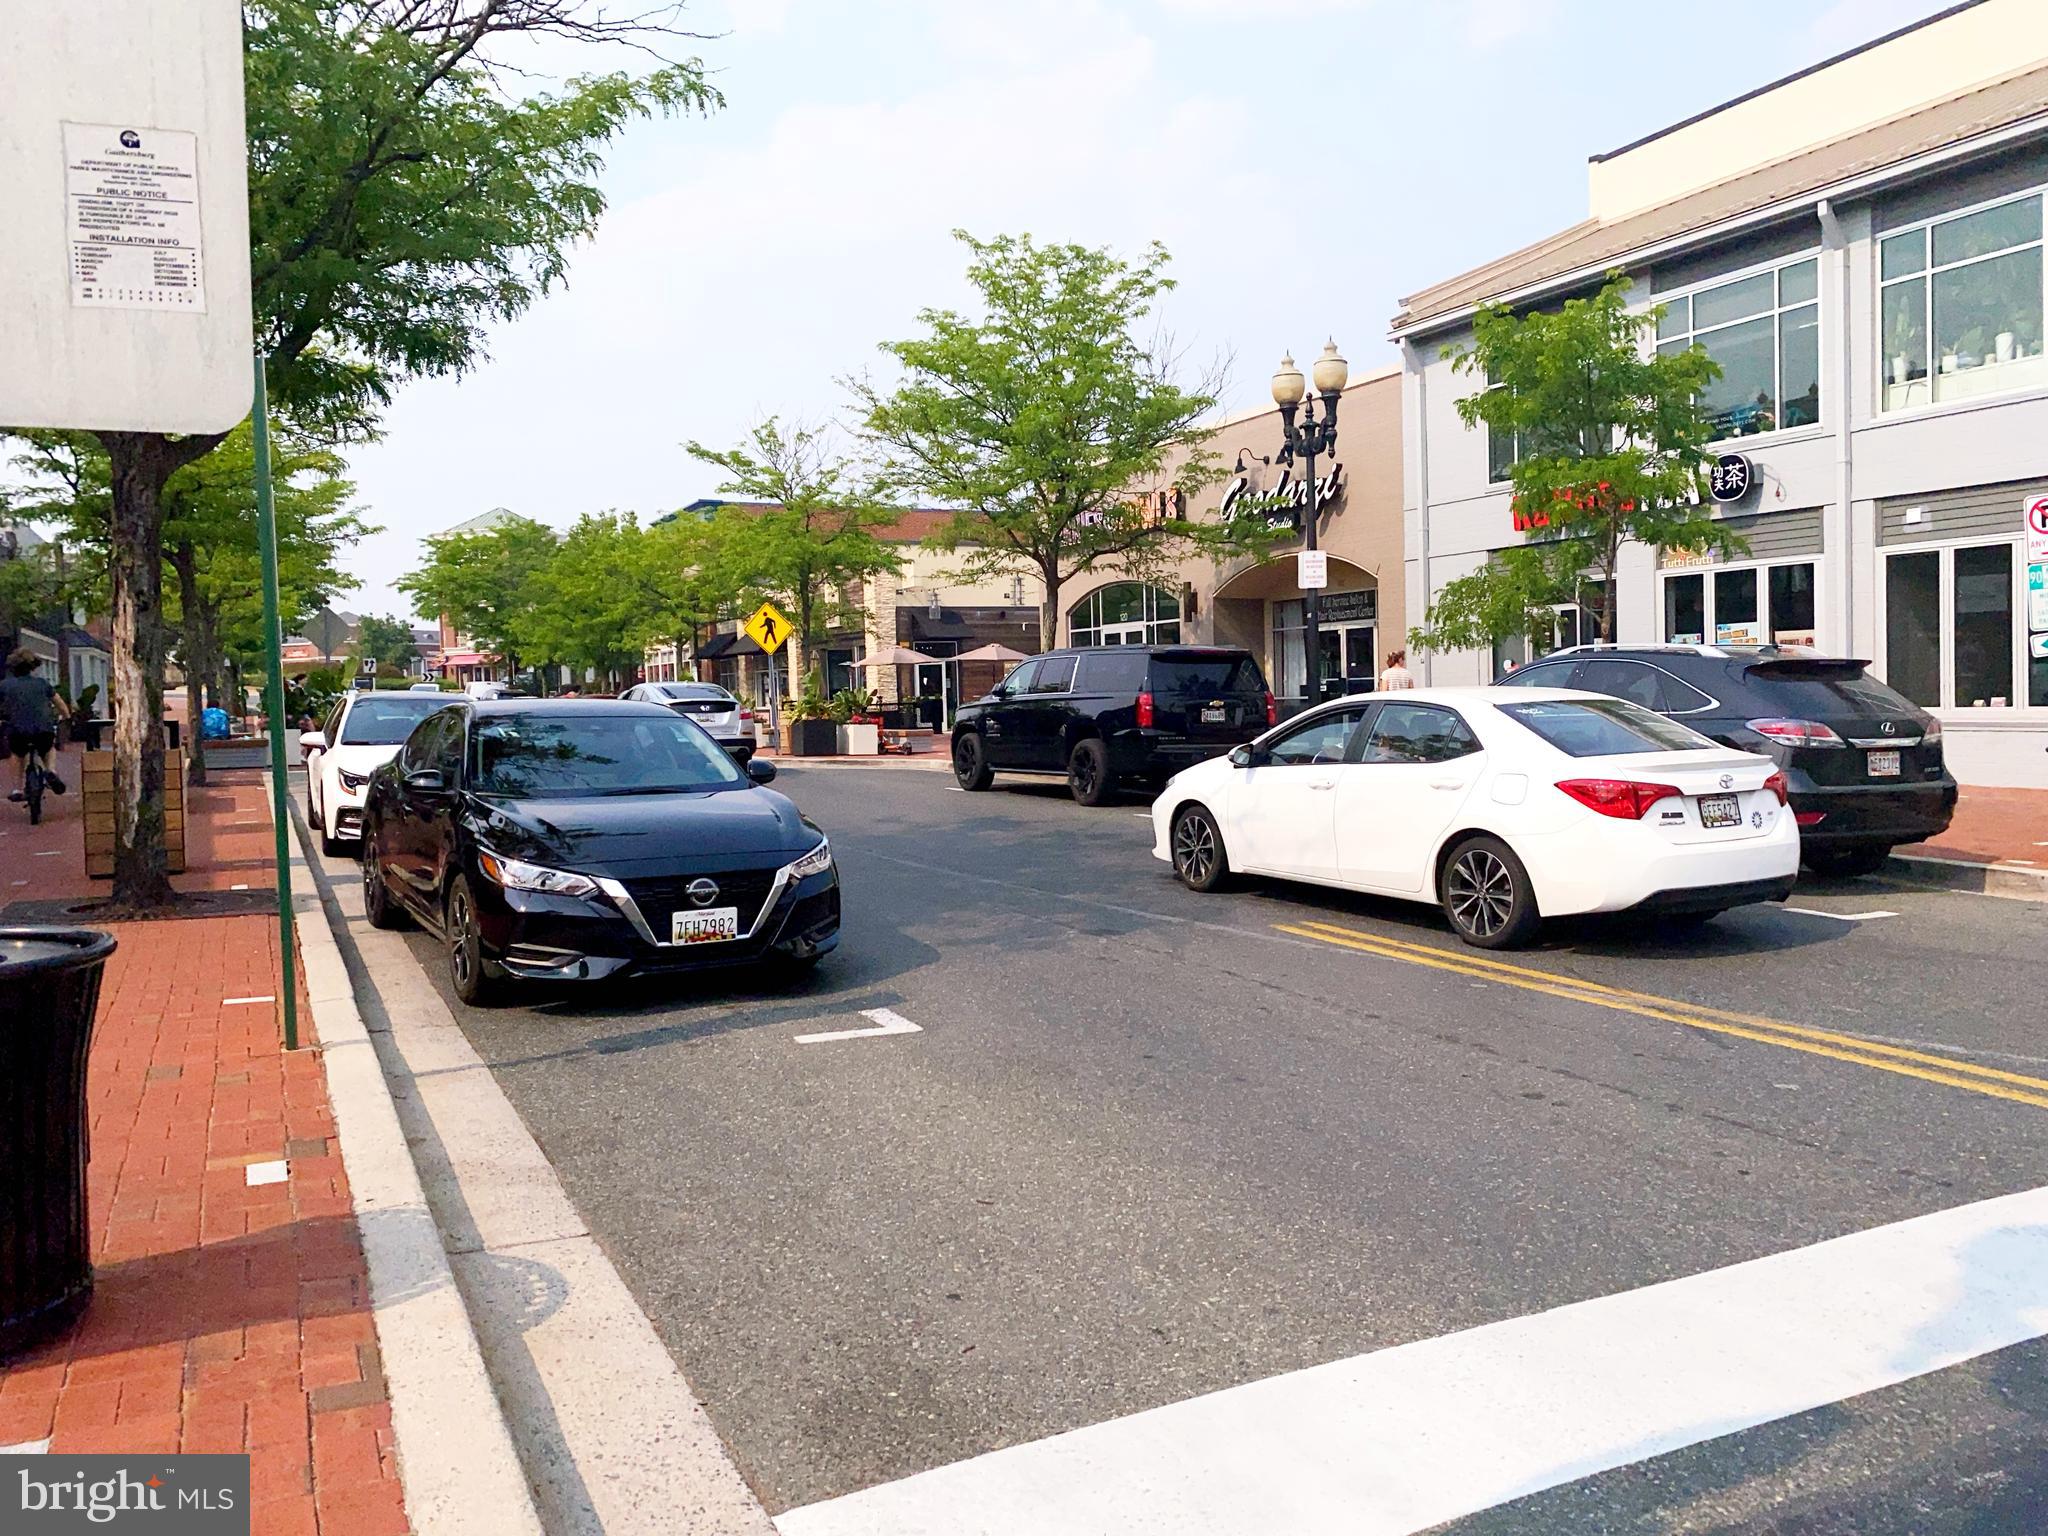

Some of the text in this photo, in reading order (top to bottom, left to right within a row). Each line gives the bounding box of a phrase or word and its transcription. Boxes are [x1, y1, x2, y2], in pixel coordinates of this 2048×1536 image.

[105, 148, 155, 159] Gaithersburg
[96, 187, 168, 199] PUBLIC NOTICE
[89, 234, 180, 246] INSTALLATION INFO
[1267, 516, 1293, 531] Studio
[1661, 555, 1714, 568] Tutti Frutti
[2030, 571, 2043, 584] 90
